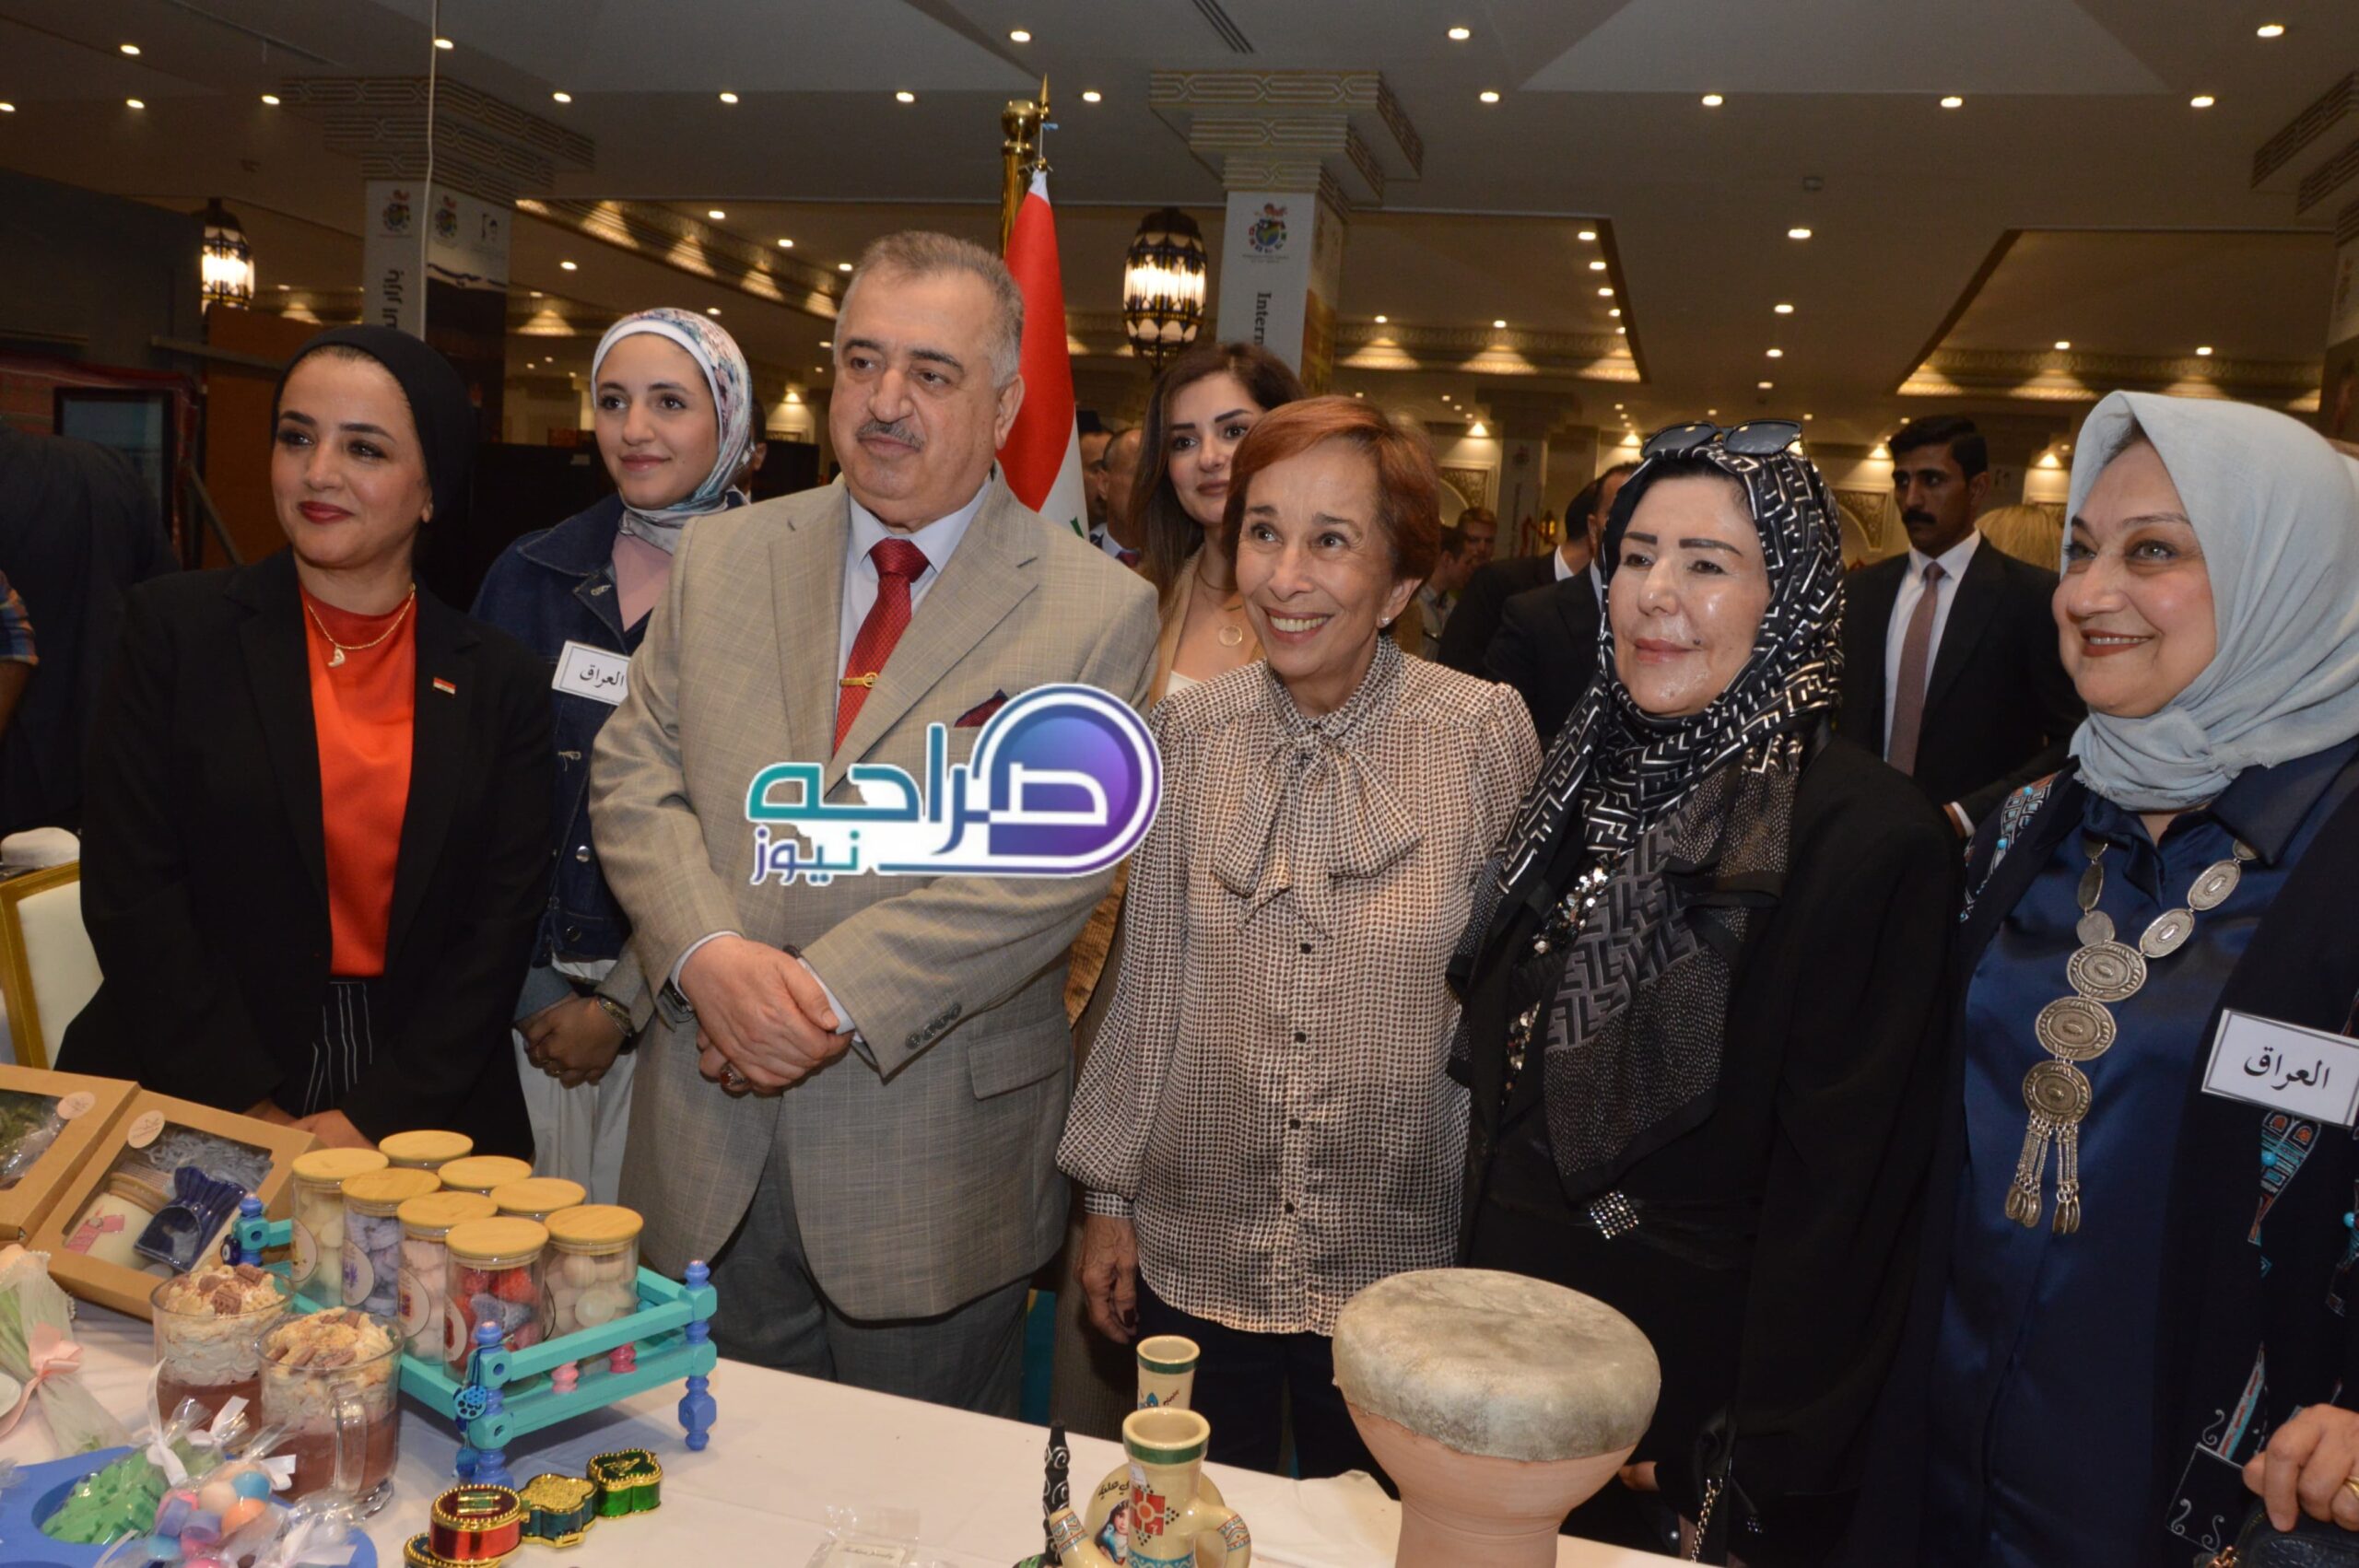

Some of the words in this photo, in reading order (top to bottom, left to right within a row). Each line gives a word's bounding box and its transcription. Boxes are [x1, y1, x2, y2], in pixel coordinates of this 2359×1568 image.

[383, 269, 405, 304] بازار
[580, 664, 625, 688] العراق
[2244, 1047, 2330, 1091] العراق
